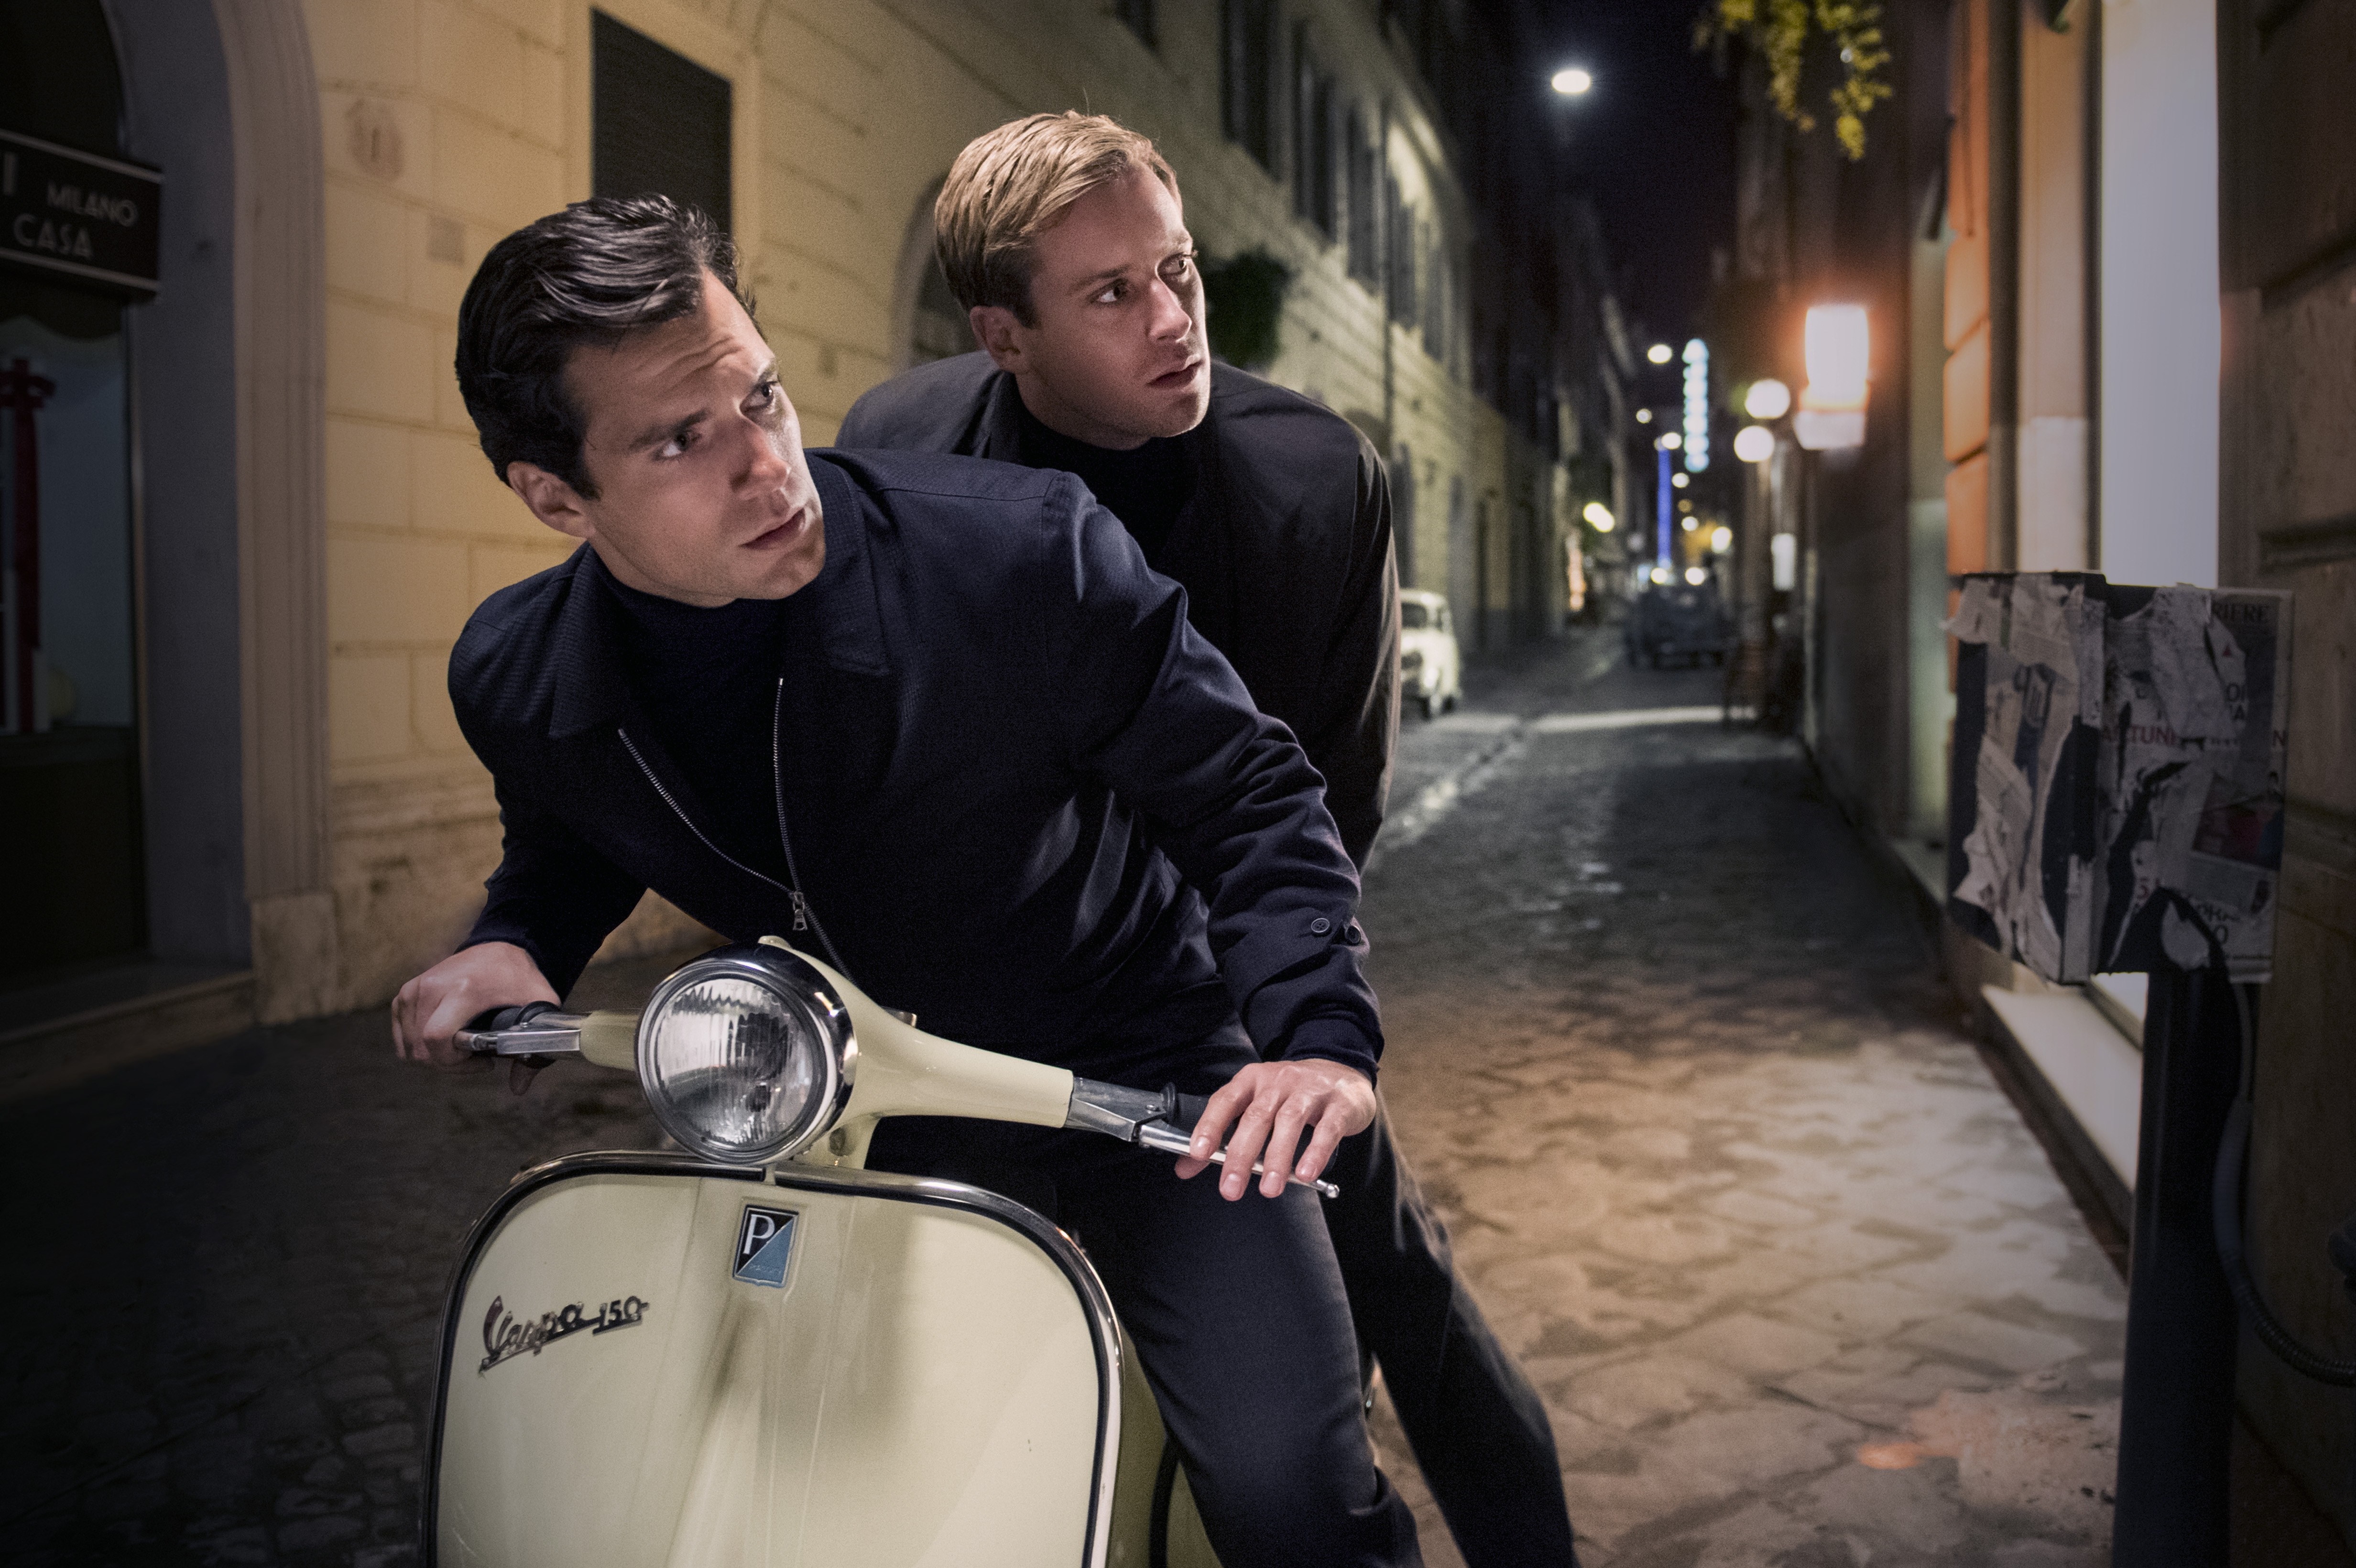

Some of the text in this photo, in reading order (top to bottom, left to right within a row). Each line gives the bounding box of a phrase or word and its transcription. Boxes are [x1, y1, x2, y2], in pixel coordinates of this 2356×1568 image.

[47, 180, 139, 228] MILANO
[14, 213, 94, 260] CASA
[742, 1213, 775, 1255] P
[480, 1295, 650, 1370] Vespa 150
